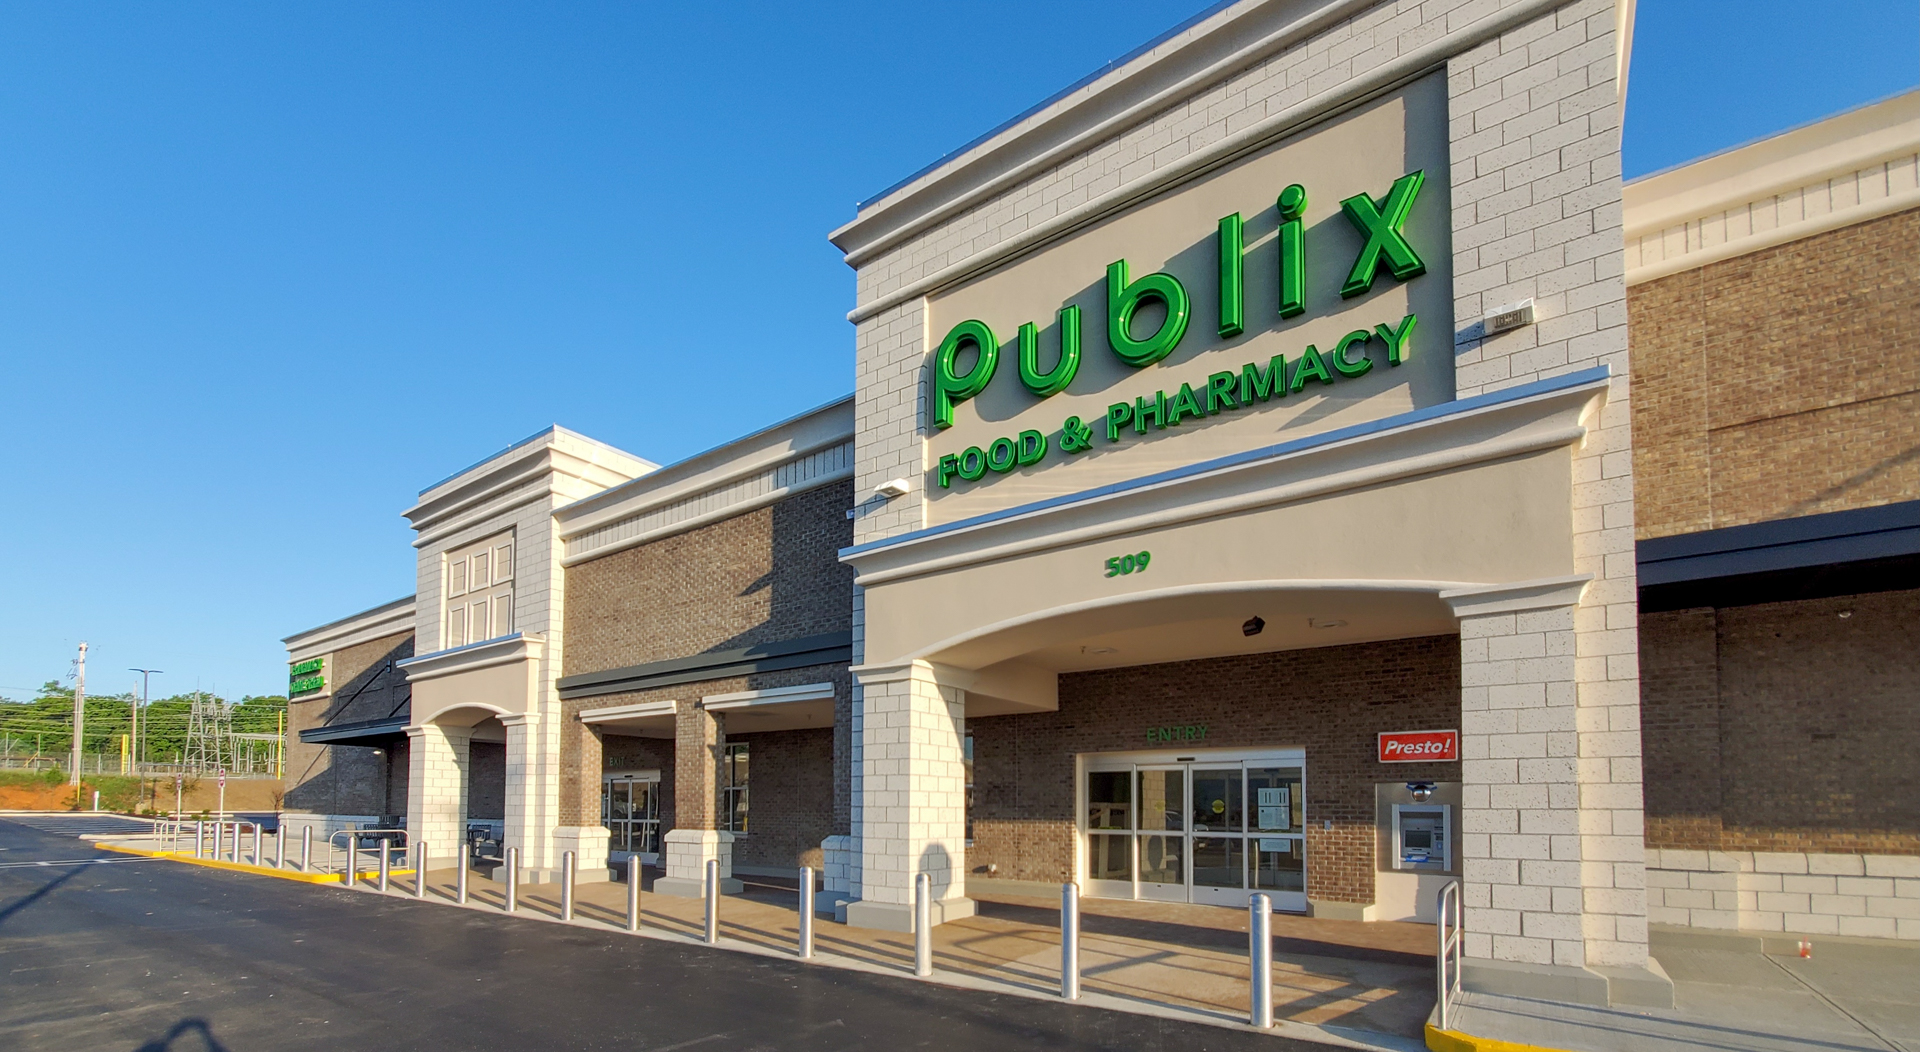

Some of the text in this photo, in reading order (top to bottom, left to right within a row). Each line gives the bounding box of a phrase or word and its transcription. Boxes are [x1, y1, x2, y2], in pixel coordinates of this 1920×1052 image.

[937, 313, 1418, 489] FOOD & PHARMACY
[1107, 550, 1151, 578] 509
[1146, 724, 1209, 742] ENTRY
[1384, 738, 1451, 755] Presto!
[609, 756, 625, 767] EXIT
